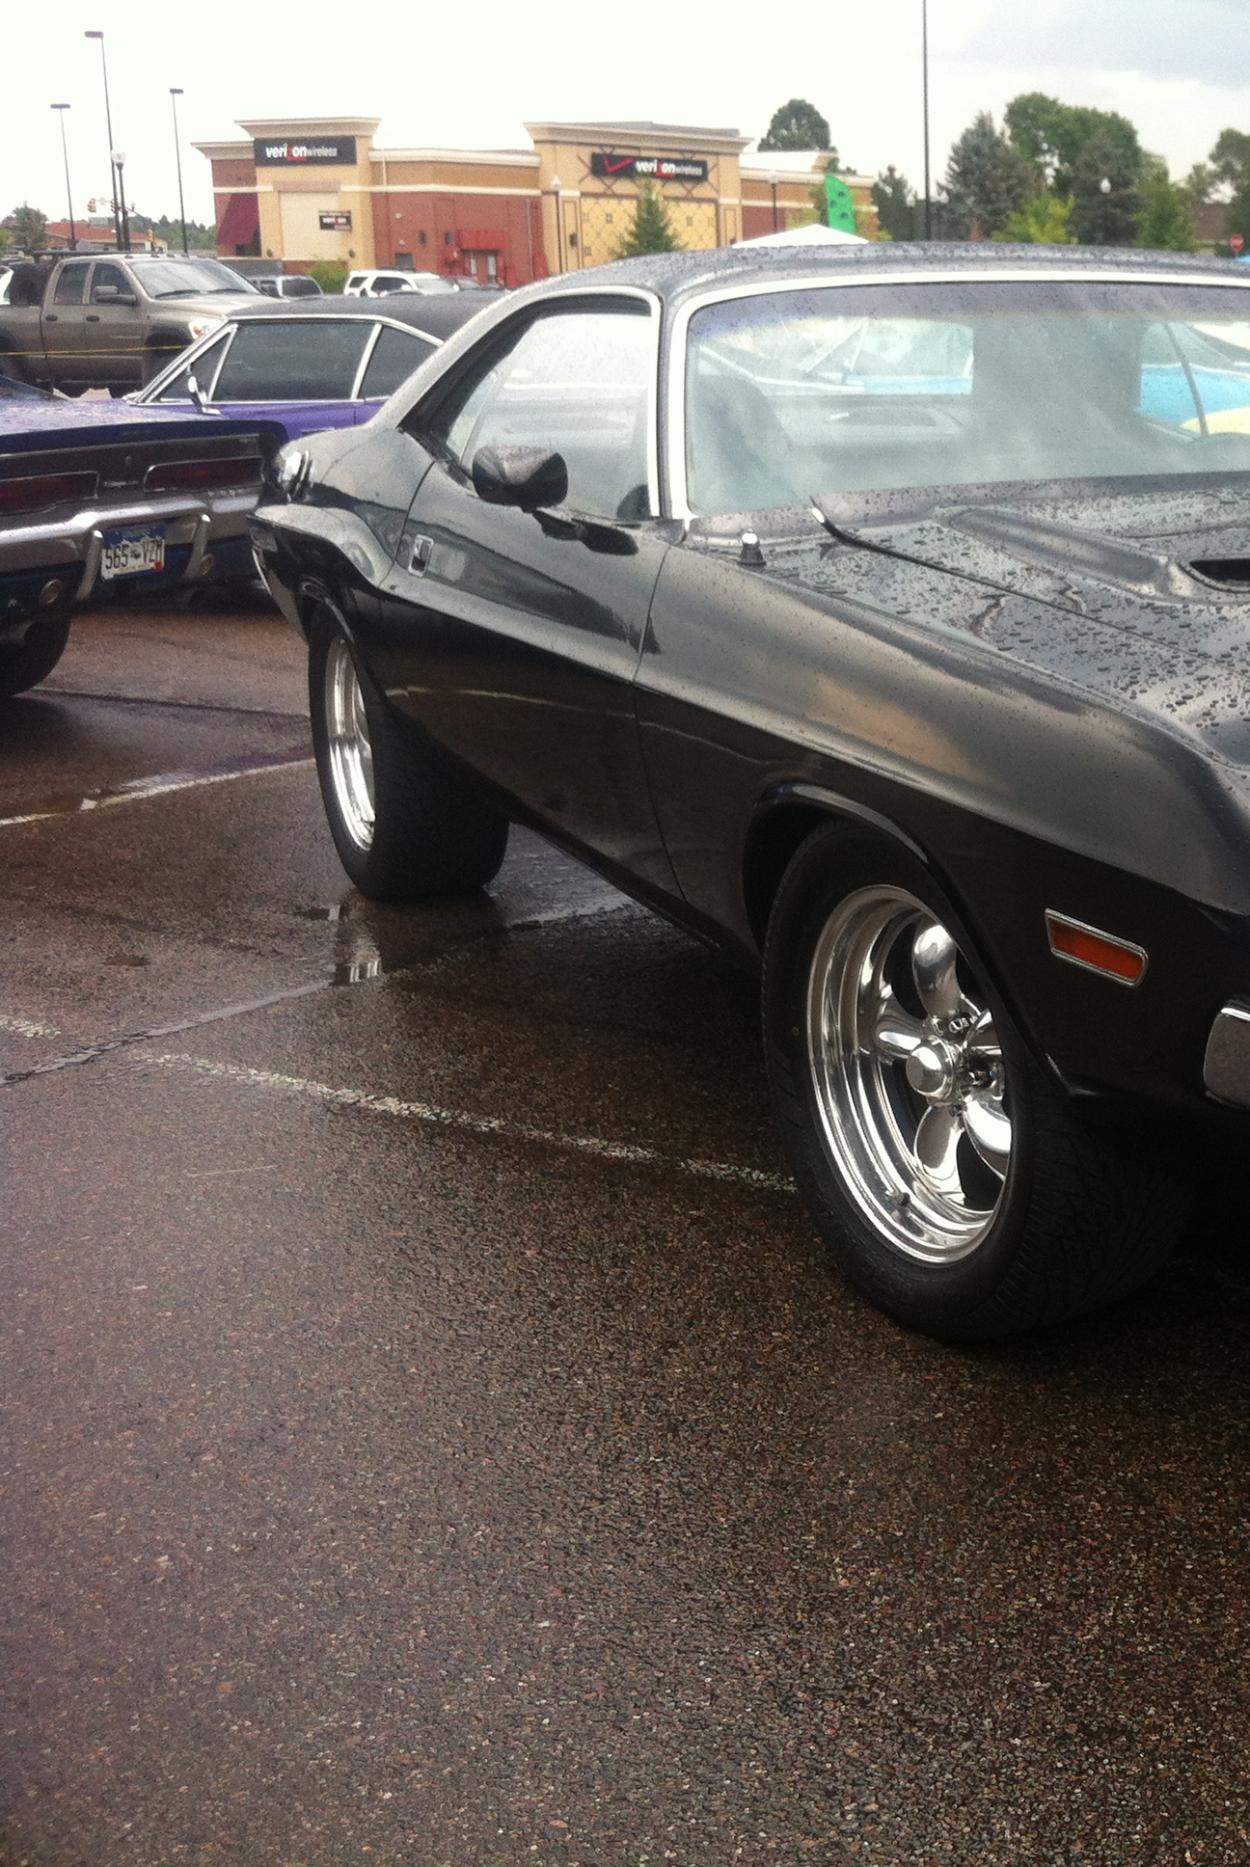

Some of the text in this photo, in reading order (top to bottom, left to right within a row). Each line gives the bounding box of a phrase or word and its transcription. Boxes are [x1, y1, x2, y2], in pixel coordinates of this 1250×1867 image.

[265, 143, 307, 160] verizon
[635, 159, 676, 177] verizon
[105, 544, 130, 570] 565
